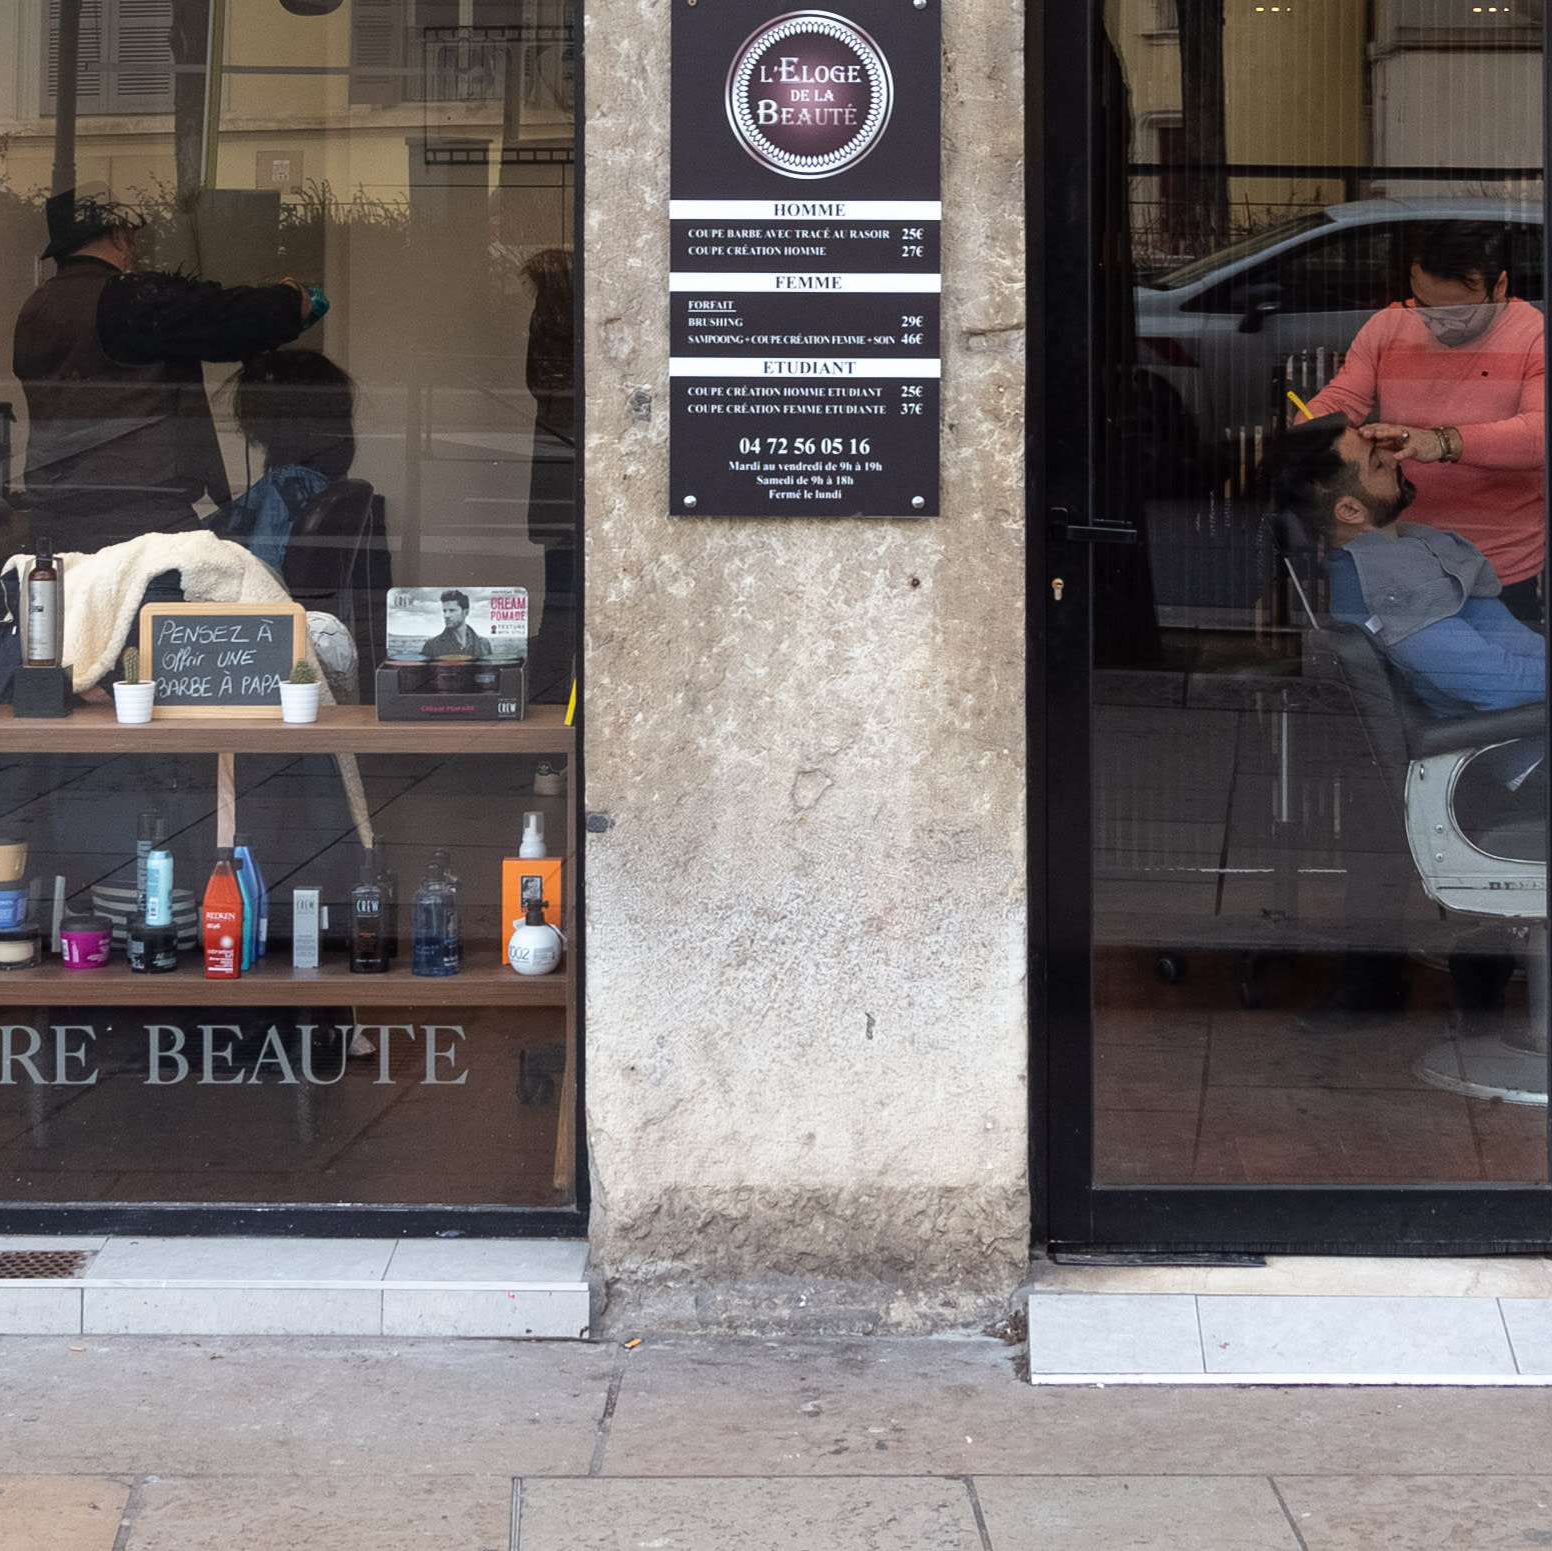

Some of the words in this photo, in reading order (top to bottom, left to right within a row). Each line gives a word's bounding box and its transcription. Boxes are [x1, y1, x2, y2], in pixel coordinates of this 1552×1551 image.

[790, 89, 810, 102] DE
[814, 89, 835, 102] LA
[757, 99, 857, 125] BEAUTÉ
[774, 203, 846, 216] HOMME
[688, 229, 725, 239] COUPE
[727, 229, 763, 239] BARBE
[764, 229, 792, 239] AVEC
[795, 227, 831, 239] TRACÉ
[832, 230, 847, 239] AU
[850, 229, 890, 239] RASOIR
[901, 227, 925, 240] 25€
[688, 246, 725, 256] COUPE
[726, 244, 782, 256] CRÉATION
[784, 247, 827, 256] HOMME
[901, 245, 925, 257] 27€
[776, 276, 842, 289] FEMME
[688, 300, 735, 311] FORFAIT
[688, 317, 743, 327] BRUSHING
[901, 315, 925, 327] 29€
[687, 335, 744, 344] SAMPOOING
[751, 335, 783, 344] COUPE
[783, 333, 831, 345] CRÉATION
[832, 335, 866, 345] FEMME
[873, 336, 896, 345] SOIN
[900, 333, 924, 345] 46€
[764, 361, 857, 375] ETUDIANT
[687, 387, 725, 397] COUPE
[726, 385, 782, 397] CRÉATION
[783, 387, 826, 397] HOMME
[828, 387, 883, 397] ETUDIANT
[900, 386, 924, 398] 25€
[687, 404, 725, 414] COUPE
[726, 402, 782, 414] CRÉATION
[783, 404, 823, 414] FEMME
[825, 405, 887, 415] ETUDIANTE
[900, 403, 924, 415] 37€
[739, 437, 761, 454] 04
[766, 437, 788, 454] 72
[793, 437, 816, 454] 56
[821, 437, 843, 454] 05
[850, 437, 871, 454] 16
[729, 461, 761, 471] Mardi
[762, 463, 776, 471] au
[778, 461, 823, 471] vendredi
[825, 461, 838, 471] de
[839, 461, 852, 471] 9h
[854, 461, 862, 471] à
[864, 461, 883, 471] 19h
[756, 475, 794, 485] Samedi
[796, 475, 808, 485] de
[811, 475, 824, 485] 9h
[826, 475, 833, 485] à
[836, 475, 854, 485] 18h
[769, 489, 802, 499] Fermé
[803, 489, 814, 499] le
[815, 489, 842, 499] lundi
[491, 597, 526, 609] CREAM
[491, 611, 526, 621] POMADE
[157, 619, 250, 646] PENSEZ
[217, 649, 257, 667] UNE
[356, 899, 379, 913] CREW
[206, 911, 236, 920] REDKEN
[143, 1024, 469, 1085] BEAUTE
